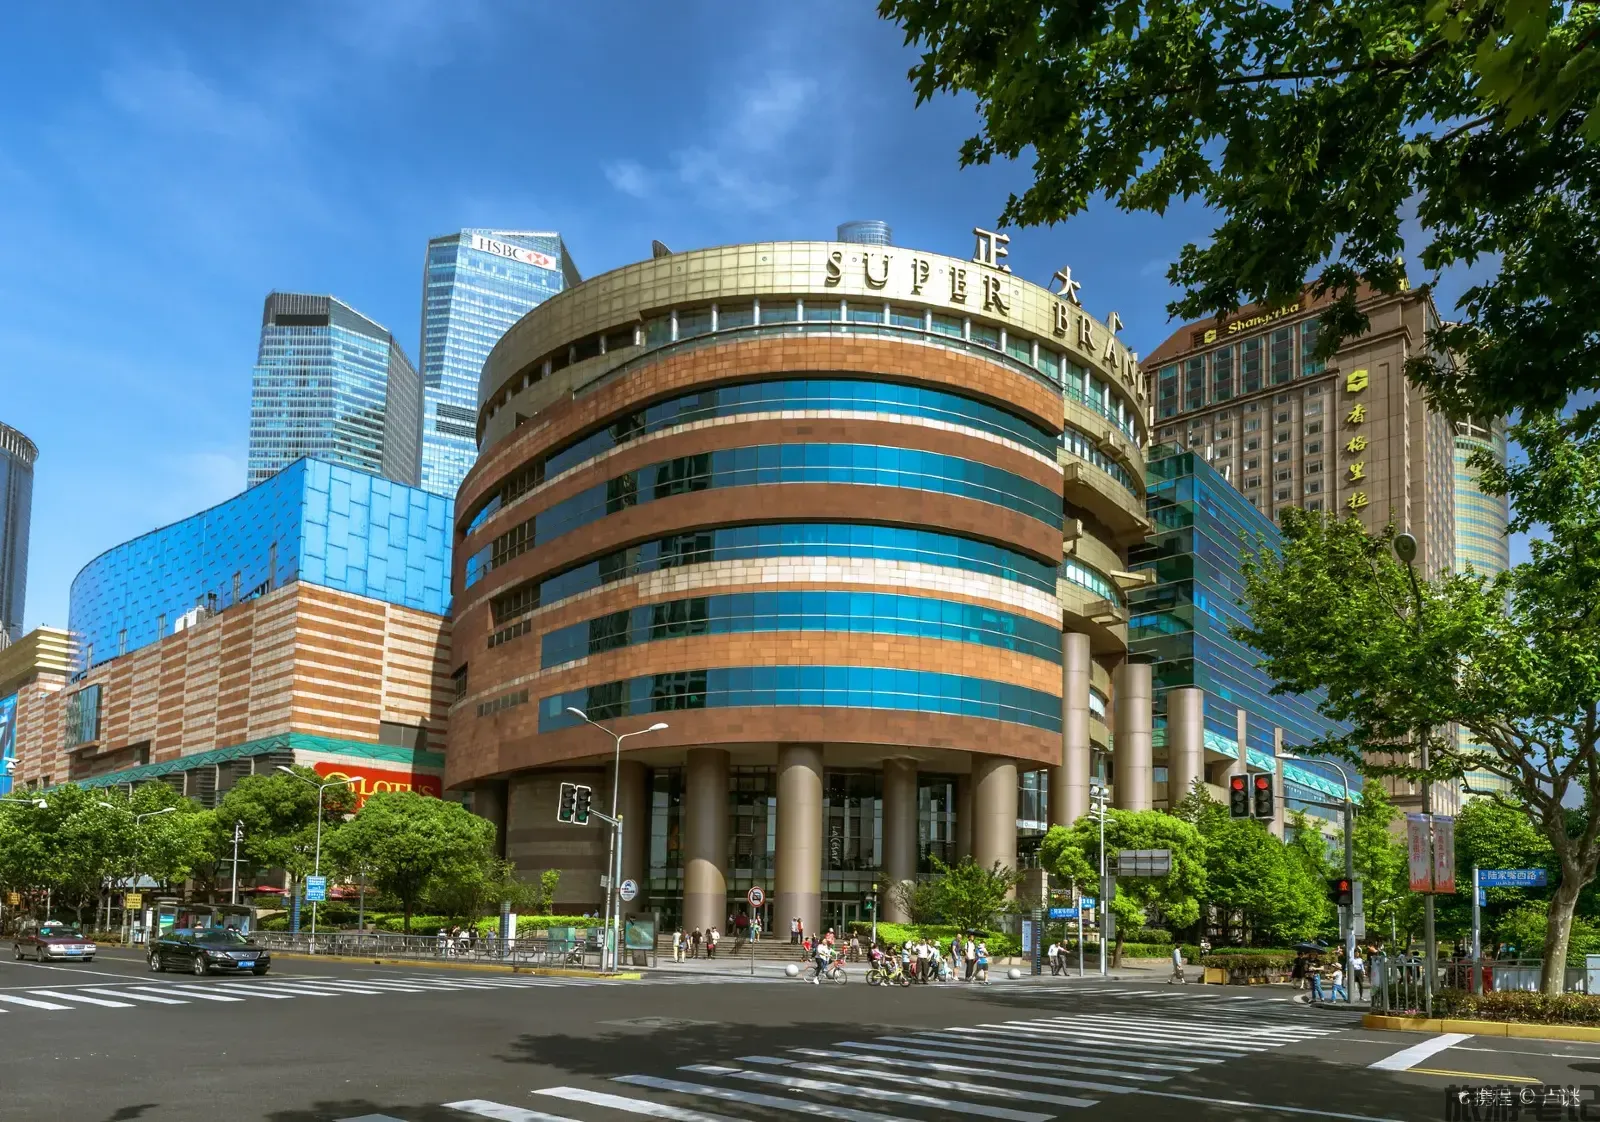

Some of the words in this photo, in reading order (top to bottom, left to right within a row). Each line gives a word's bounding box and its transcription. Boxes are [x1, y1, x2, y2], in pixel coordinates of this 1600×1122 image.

[480, 238, 525, 260] HSBC
[826, 250, 1010, 315] SUPER
[1053, 301, 1148, 400] BRAND
[1346, 403, 1370, 509] 香格里拉
[1487, 870, 1537, 880] 陆家嘴西路
